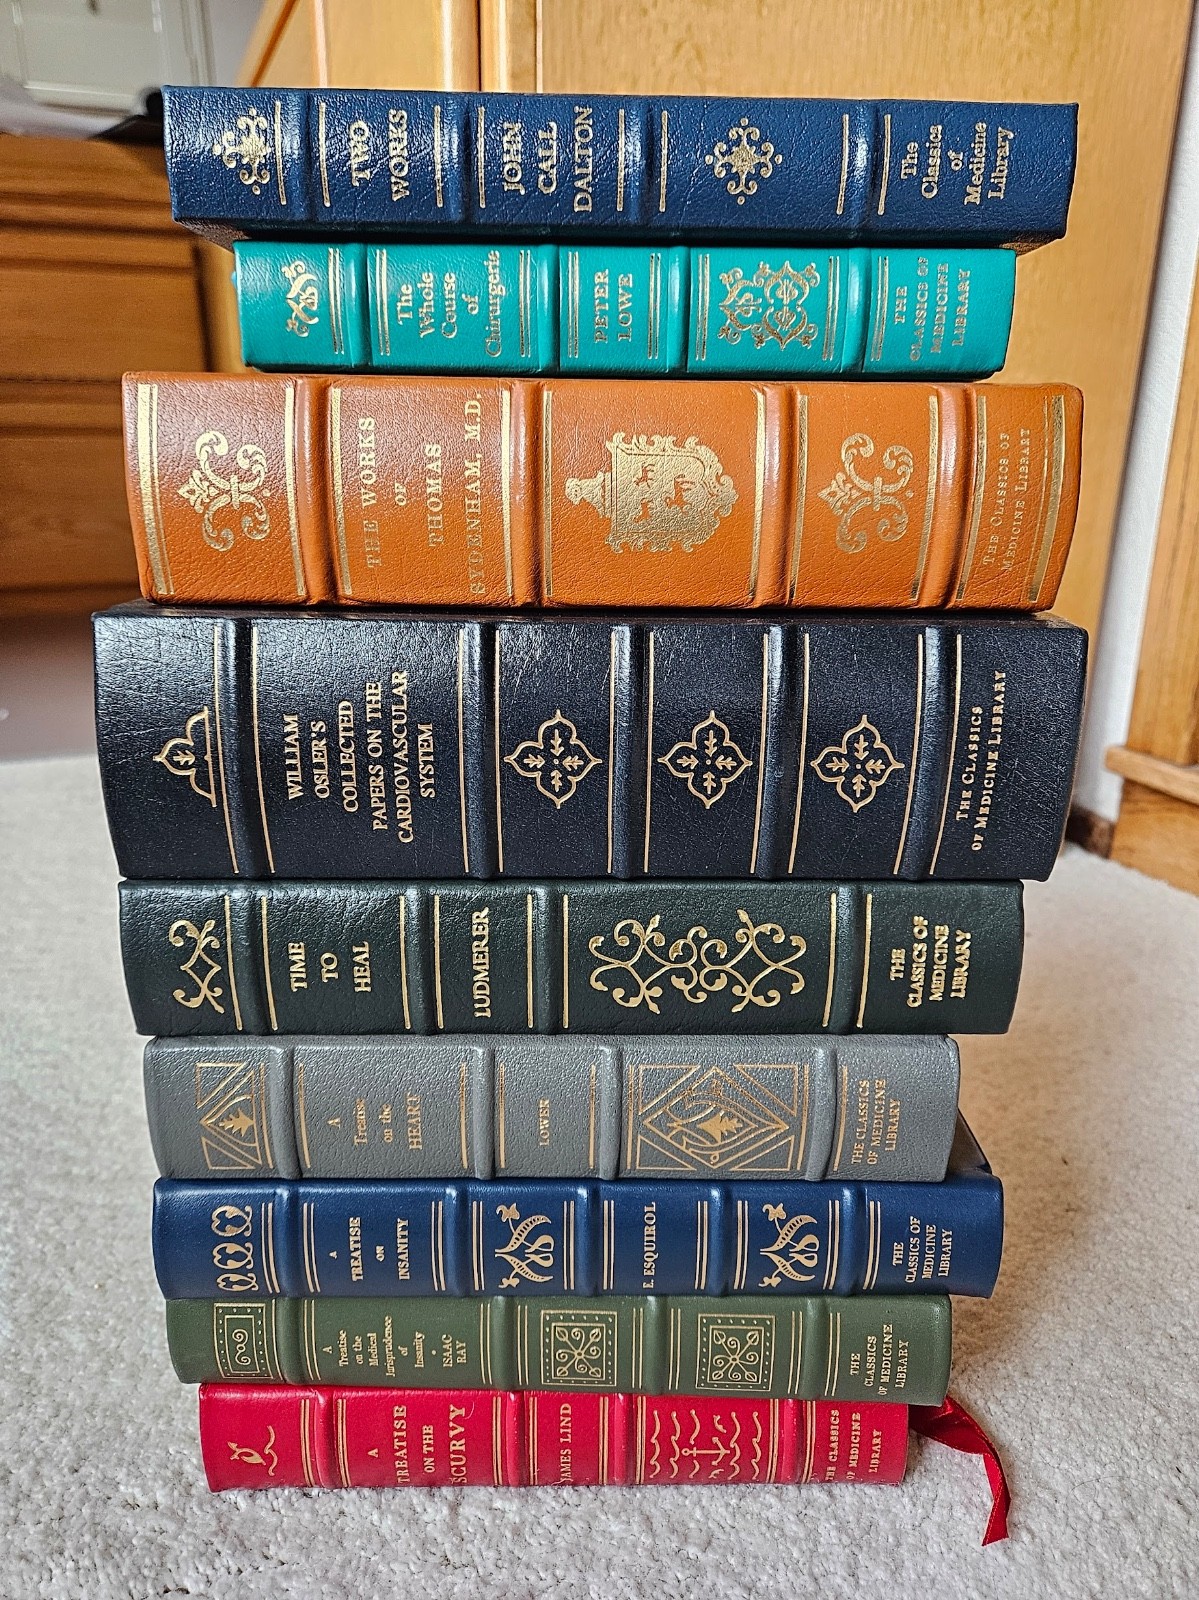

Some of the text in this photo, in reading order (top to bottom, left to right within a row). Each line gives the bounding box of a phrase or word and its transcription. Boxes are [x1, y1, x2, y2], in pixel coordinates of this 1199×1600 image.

[349, 120, 370, 187] TWO
[389, 109, 410, 201] WORKS
[503, 122, 525, 195] JOHN
[538, 122, 557, 194] CALL
[573, 106, 593, 212] DALTON
[901, 142, 918, 179] The
[922, 125, 942, 199] Classics
[948, 150, 963, 171] of
[964, 122, 987, 205] Medicine
[988, 127, 1013, 199] Library
[397, 283, 413, 325] The
[417, 272, 435, 338] Whole
[441, 272, 457, 338] Course
[462, 294, 479, 315] of
[594, 269, 609, 343] PETER
[618, 273, 633, 342] LOWE
[894, 286, 907, 325] THE
[910, 257, 928, 361] CLASSICS OF
[930, 263, 948, 353] MEDICINE
[952, 269, 970, 346] LIBRARY
[359, 416, 381, 568] THE WORKS
[395, 482, 407, 506] OF
[425, 443, 444, 547] THOMAS
[464, 394, 485, 594] SYDENHAM, M.D.
[283, 714, 304, 800] WILLIAM
[311, 720, 330, 798] OSLER'S
[339, 700, 358, 812] COLLECTED
[366, 682, 388, 830] PAPERS ON THE
[391, 671, 413, 843] CARDIOVASCULAR
[418, 723, 435, 798] SYSTEM
[288, 941, 308, 992] TIME
[320, 952, 339, 982] TO
[353, 941, 371, 993] HEAL
[472, 907, 491, 1018] LUDMERER
[890, 948, 905, 980] THE
[907, 916, 928, 1008] CLASSICS OF
[929, 925, 949, 1001] MEDICINE
[950, 930, 971, 998] LIBRARY
[327, 1117, 341, 1129] A
[353, 1098, 368, 1145] Treatise
[379, 1103, 393, 1143] on the
[405, 1092, 423, 1150] HEART
[539, 1098, 550, 1146] LOWER
[851, 1080, 870, 1164] THE CLASSICS
[867, 1080, 886, 1165] OF MEDICINE
[885, 1099, 900, 1151] LIBRARY
[329, 1251, 337, 1259] A
[349, 1217, 363, 1281] TREATISE
[376, 1246, 385, 1262] ON
[397, 1218, 410, 1280] INSANITY
[642, 1201, 658, 1288] E. ESQUIROL
[892, 1242, 904, 1266] THE
[905, 1216, 921, 1283] CLASSICS OF
[922, 1225, 936, 1279] MEDICINE
[938, 1229, 952, 1277] LIBRARY
[323, 1346, 333, 1354] A
[337, 1330, 348, 1366] Treatise
[353, 1336, 363, 1364] on the
[367, 1333, 379, 1366] Medical
[383, 1315, 396, 1377] Jurisprudence
[398, 1346, 408, 1356] of
[413, 1331, 425, 1368] Insanity
[442, 1334, 453, 1367] ISAAC
[456, 1340, 467, 1363] RAY
[850, 1353, 860, 1375] THE
[864, 1336, 877, 1386] CLASSICS
[878, 1324, 892, 1395] OF MEDICINE
[895, 1340, 909, 1388] LIBRARY
[368, 1448, 379, 1458] A
[393, 1405, 410, 1483] TREATISE
[422, 1425, 435, 1473] ON THE
[450, 1404, 467, 1483] SCURVY
[560, 1404, 572, 1443] LIND
[829, 1410, 839, 1462] CLASSICS
[849, 1412, 860, 1467] MEDICINE
[868, 1429, 881, 1473] LIBRARY
